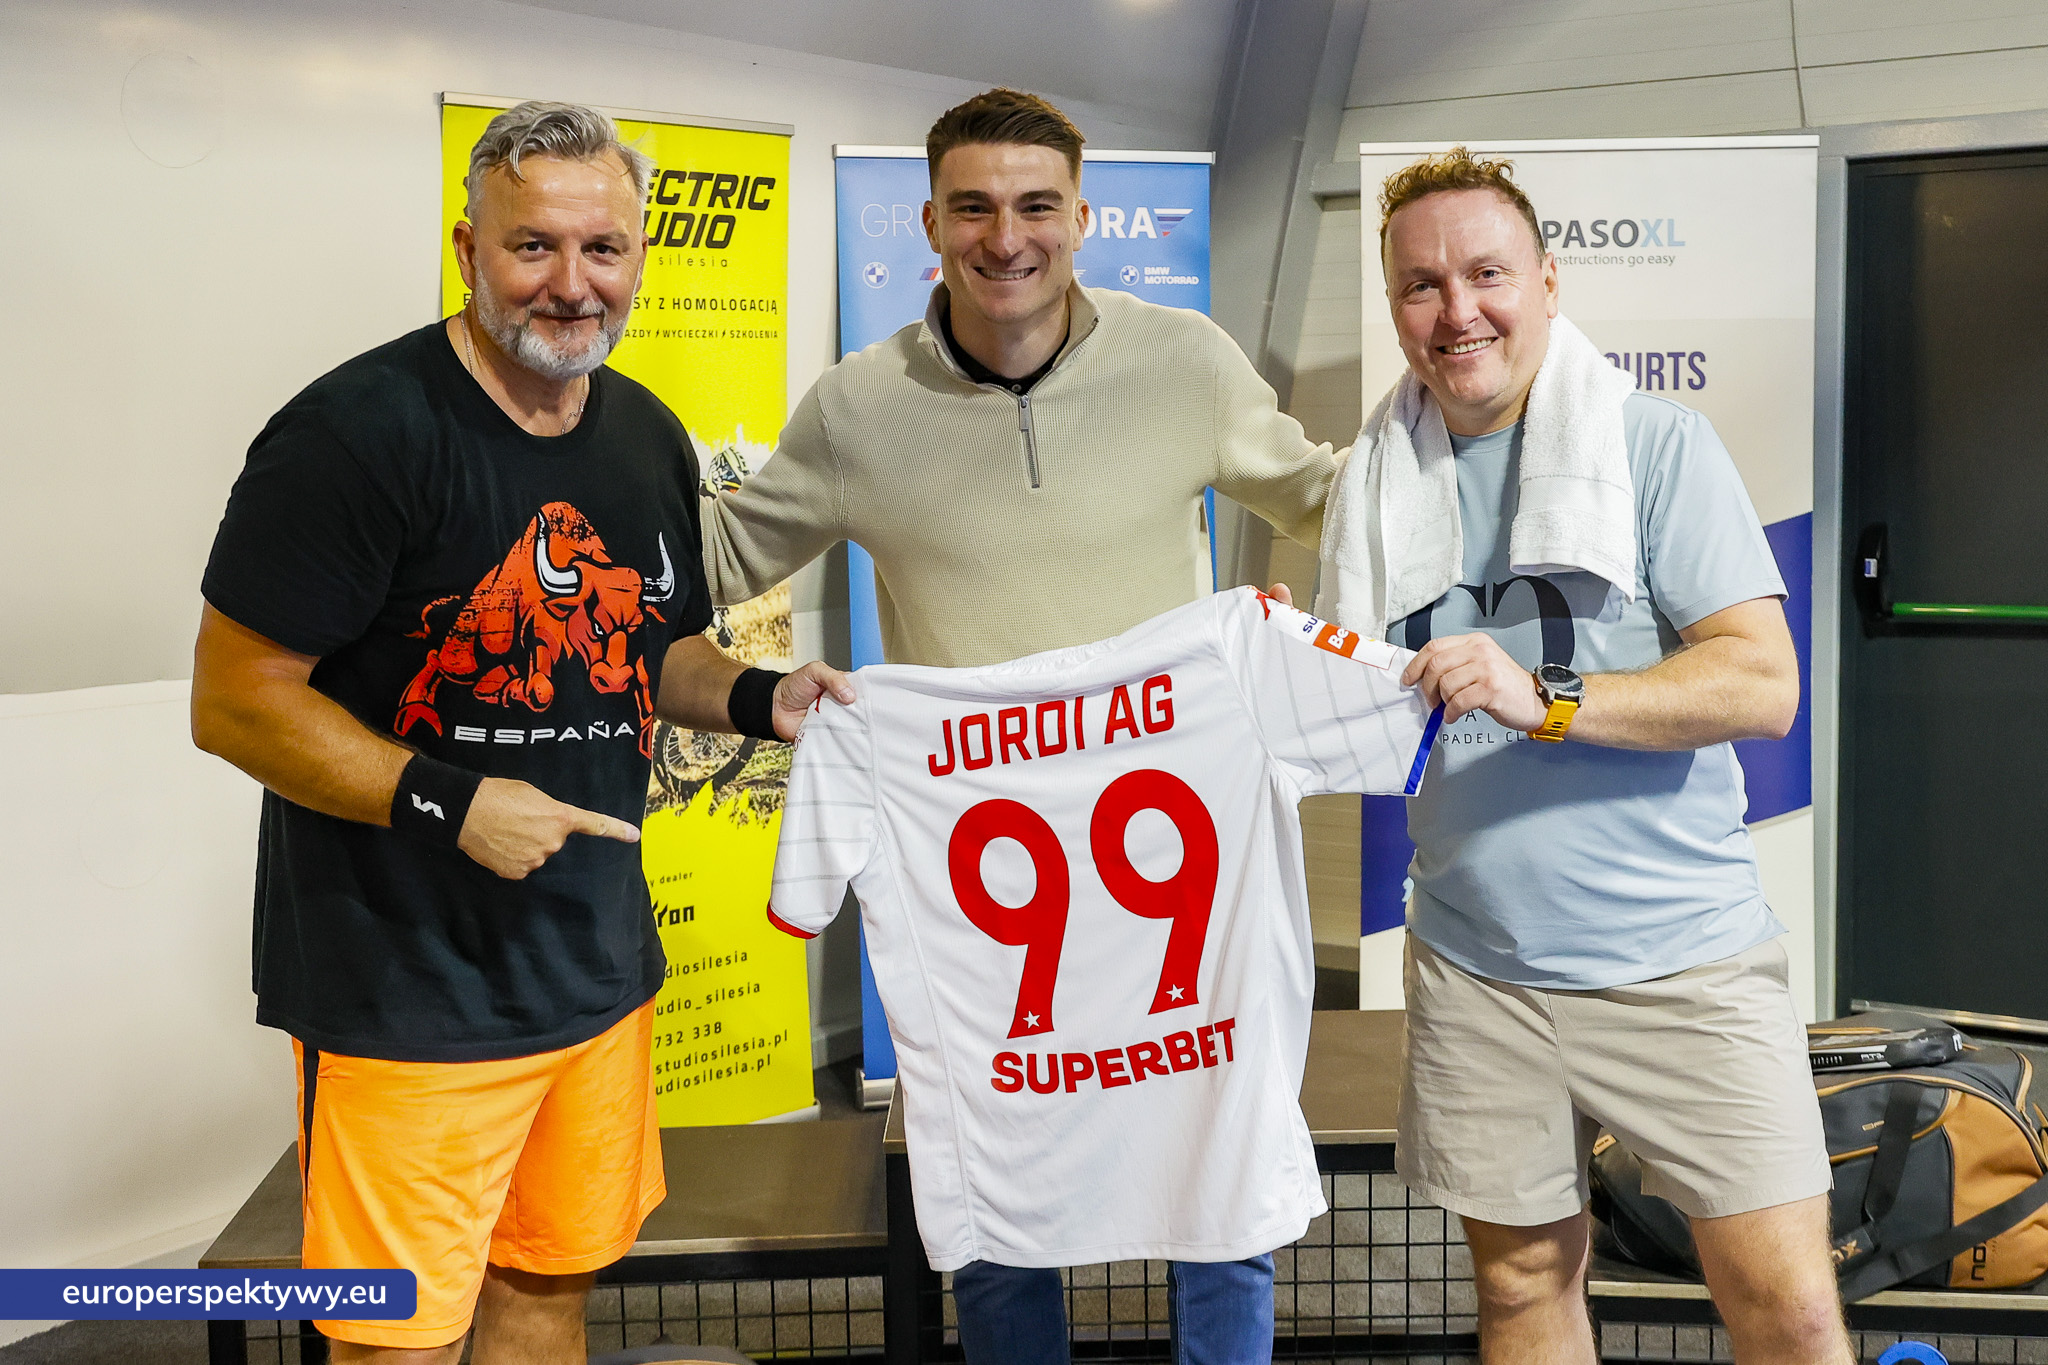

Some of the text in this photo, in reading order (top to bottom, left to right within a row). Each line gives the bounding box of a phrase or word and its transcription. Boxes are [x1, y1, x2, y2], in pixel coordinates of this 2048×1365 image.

[1542, 218, 1686, 248] PASOXL
[659, 254, 728, 267] silesia
[1144, 267, 1170, 275] BMW
[1628, 255, 1644, 267] go
[1647, 254, 1676, 267] easy
[1144, 276, 1199, 285] MOTORRAD
[659, 298, 665, 309] Z
[672, 298, 777, 314] HOMOLOGACJĄ
[624, 329, 778, 338] AZDY WYCIECZKI SZKOLENIA
[454, 721, 635, 744] ESPAÑA
[927, 673, 1175, 777] JORDI AG
[1442, 731, 1534, 744] PADEL CL
[659, 871, 693, 884] dealer
[948, 768, 1219, 1039] 99
[665, 950, 748, 979] diosilesia
[656, 981, 760, 1016] udio_silesia
[655, 1021, 722, 1049] 732 338
[655, 1029, 788, 1075] studiosilesia.pl
[991, 1017, 1236, 1095] SUPERBET
[655, 1053, 771, 1096] udiosilesia.pl
